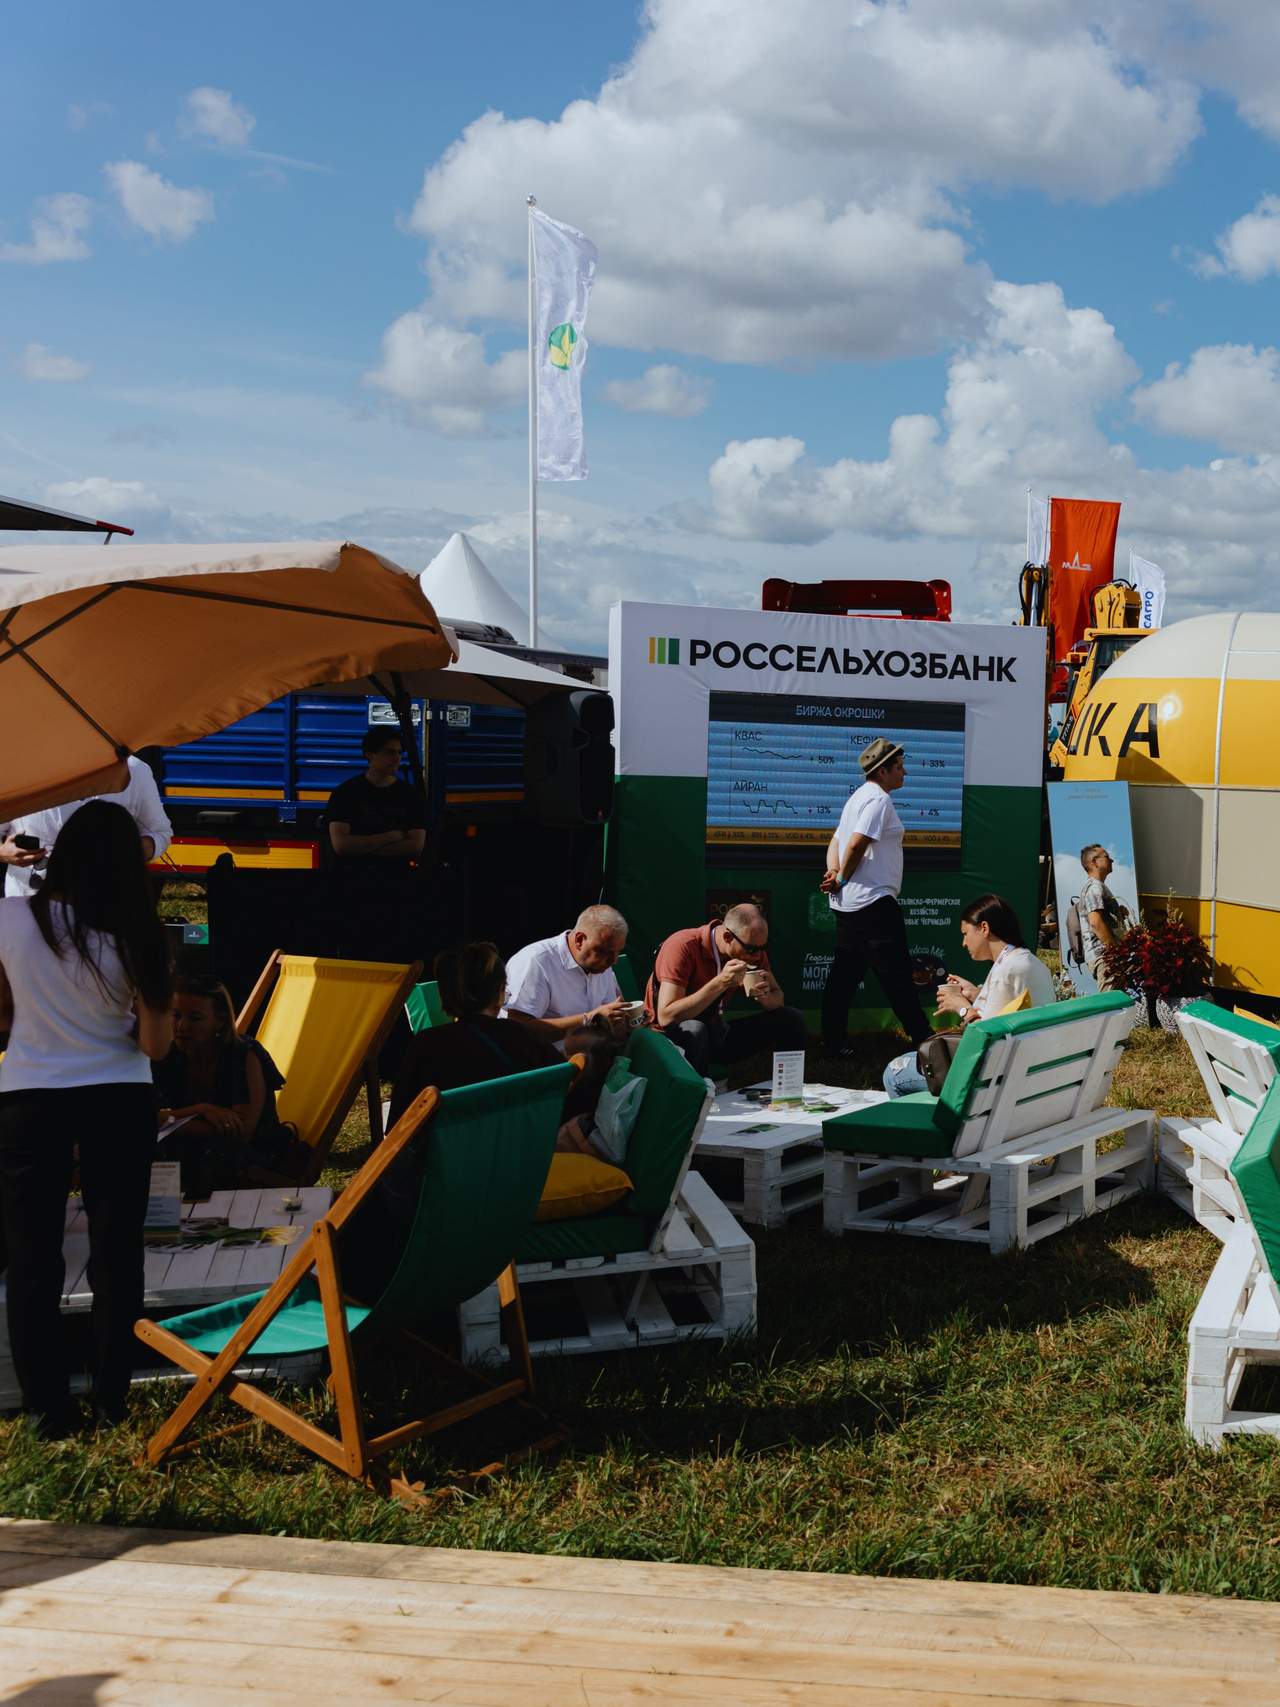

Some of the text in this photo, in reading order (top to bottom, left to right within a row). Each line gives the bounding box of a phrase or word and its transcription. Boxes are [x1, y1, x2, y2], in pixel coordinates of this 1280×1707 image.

[689, 639, 1017, 683] РОССЕЛЬХОЗБАНК
[796, 705, 885, 719] БИРЖА ОКРОШКИ
[734, 731, 762, 741] КВАС
[818, 756, 835, 764] 50%
[929, 760, 945, 768] 33%
[733, 780, 768, 792] АЙРАН
[817, 806, 831, 814] 13%
[928, 809, 940, 817] 4%
[897, 898, 961, 906] СТЬЯНСКО-ФЕРМЕРСКОЕ
[909, 907, 939, 916] ХОЗЯЙСТВО
[909, 945, 930, 956] ndoza
